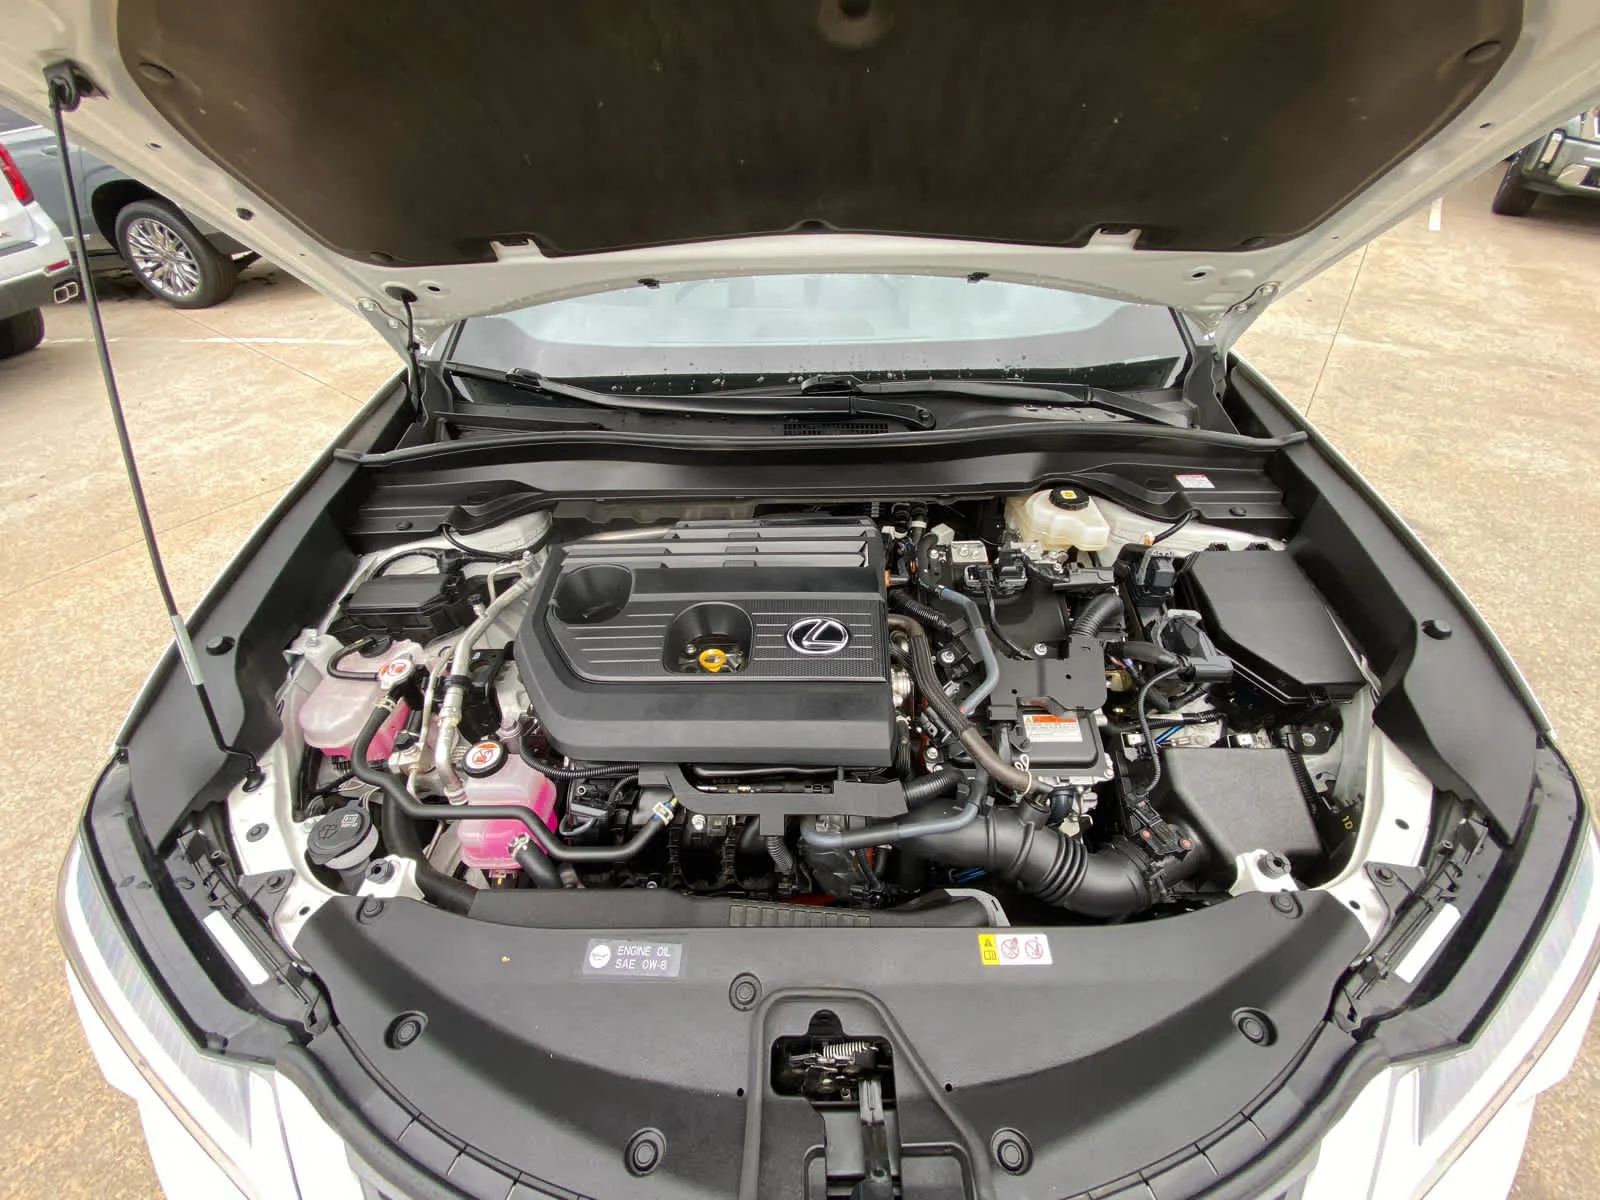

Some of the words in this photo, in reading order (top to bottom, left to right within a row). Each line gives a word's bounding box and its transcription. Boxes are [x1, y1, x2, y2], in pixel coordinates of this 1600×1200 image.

[617, 945, 652, 956] ENGINE
[657, 946, 671, 957] OIL
[615, 959, 636, 969] SAE
